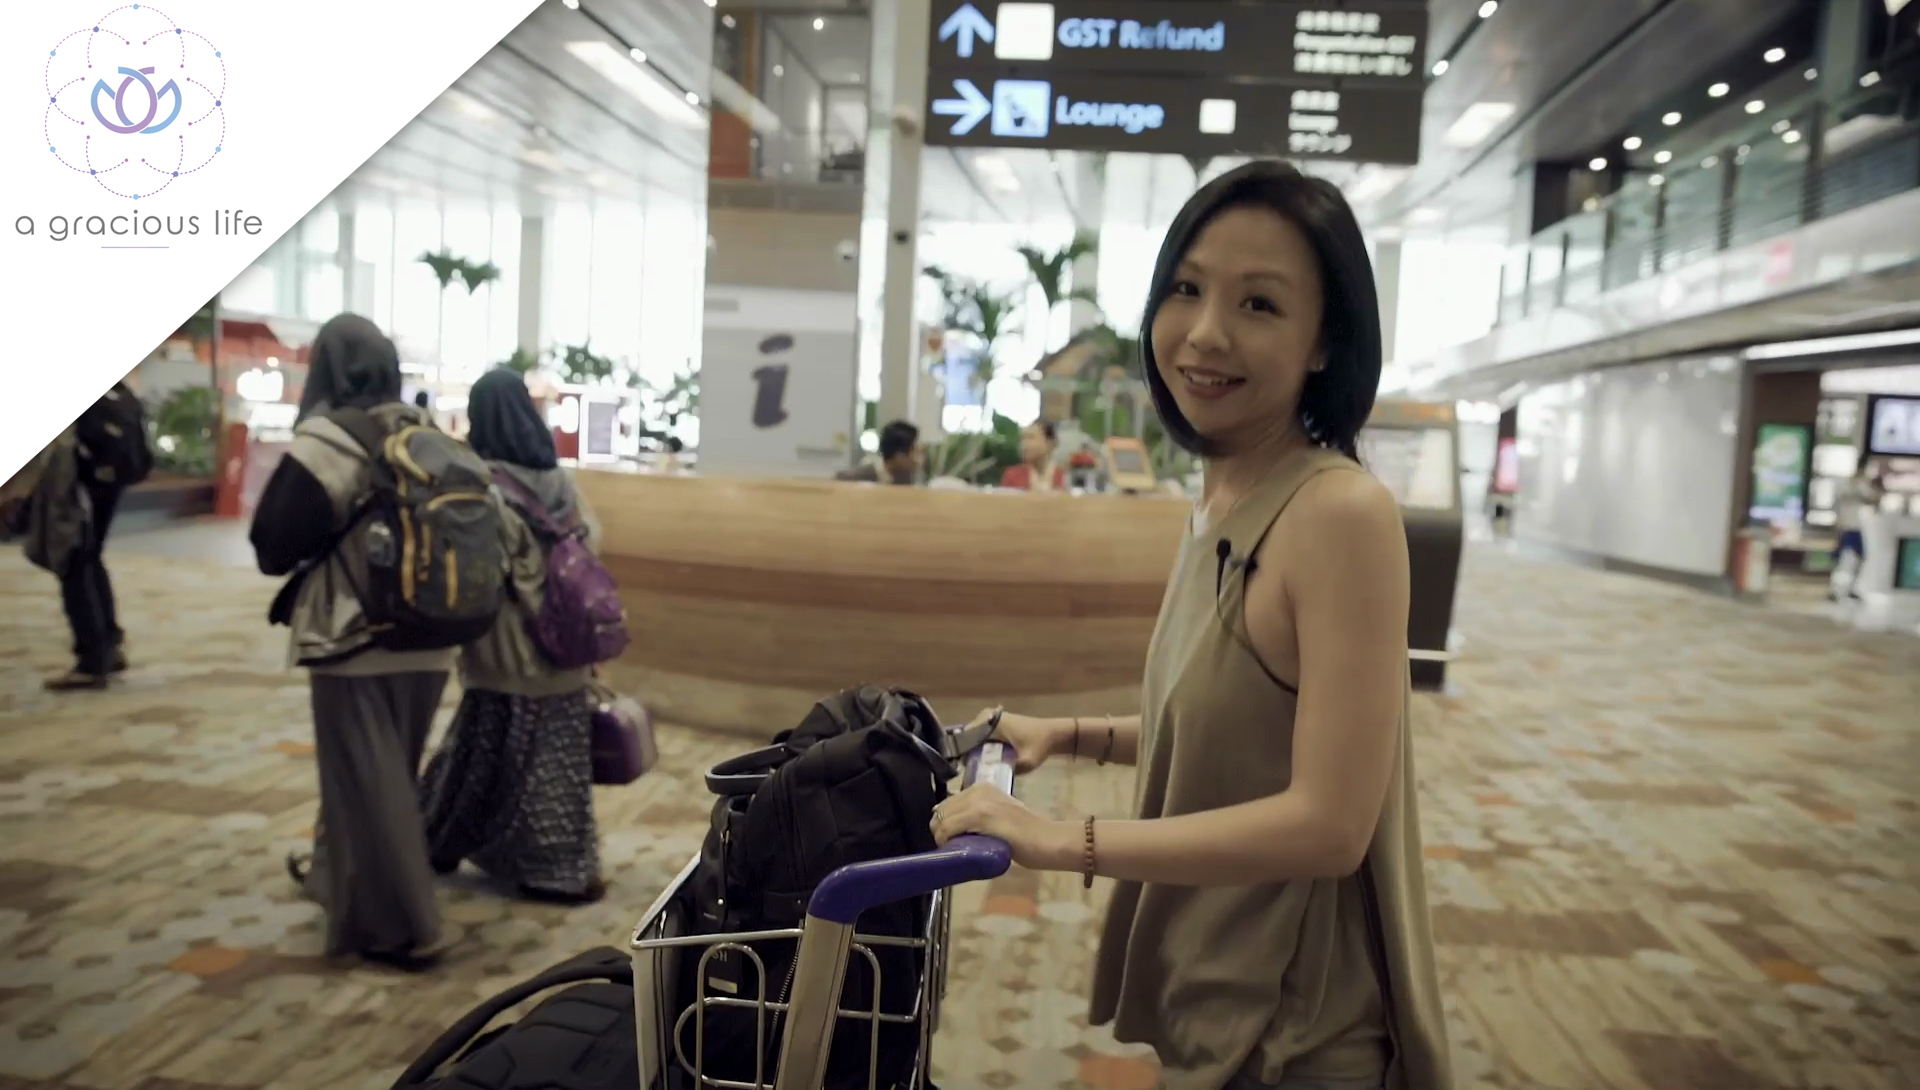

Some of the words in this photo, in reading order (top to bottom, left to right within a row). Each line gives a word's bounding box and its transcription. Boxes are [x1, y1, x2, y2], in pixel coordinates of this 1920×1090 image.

[1057, 17, 1116, 48] GST
[1119, 19, 1225, 51] Refund
[1055, 95, 1164, 132] Lounge
